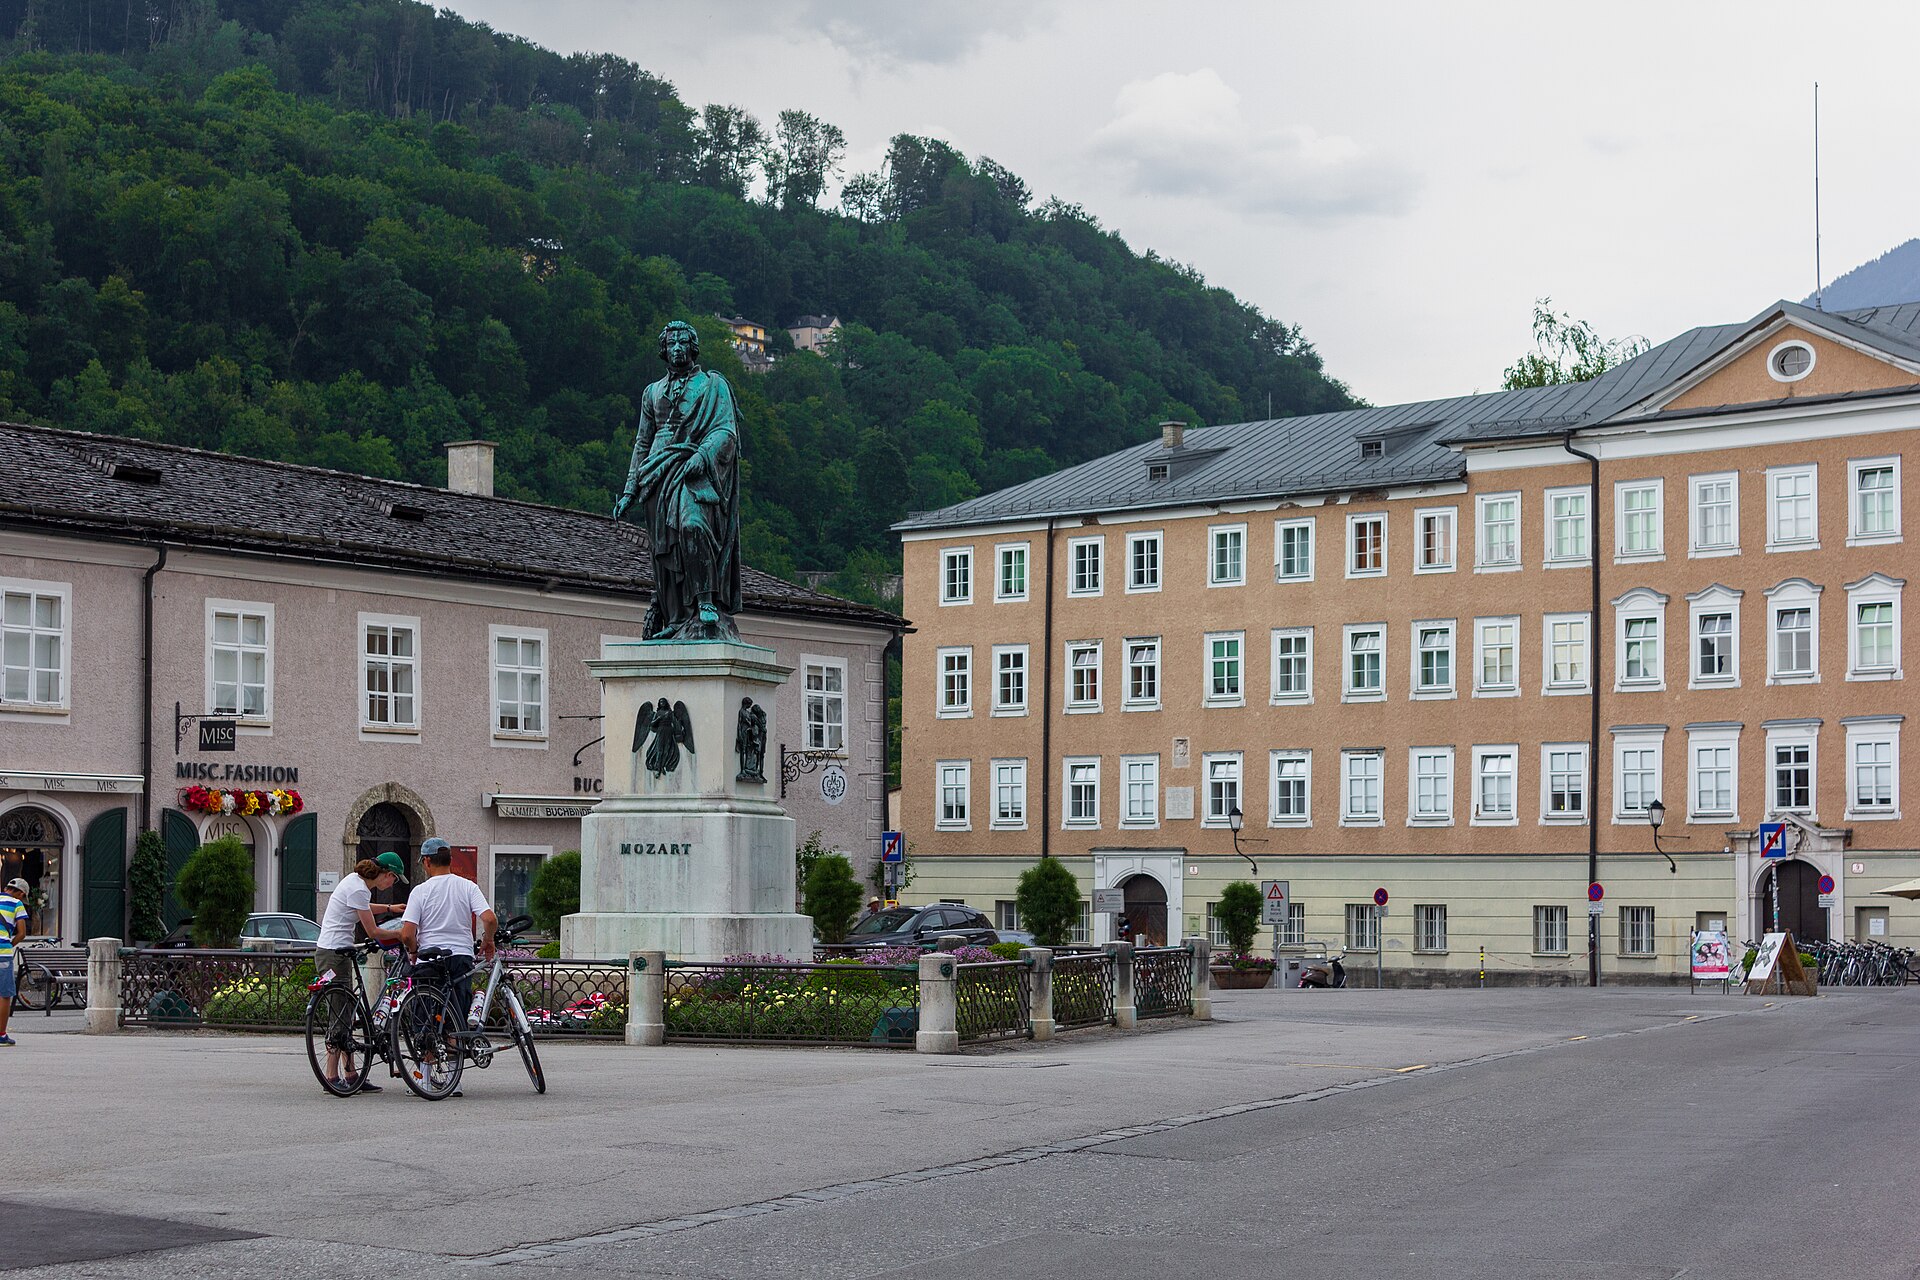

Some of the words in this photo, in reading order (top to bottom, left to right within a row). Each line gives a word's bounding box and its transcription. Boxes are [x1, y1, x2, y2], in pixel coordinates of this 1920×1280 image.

[176, 762, 299, 783] MISC.FASHION
[545, 807, 595, 817] BUCHBINDE
[620, 843, 692, 855] MOZART
